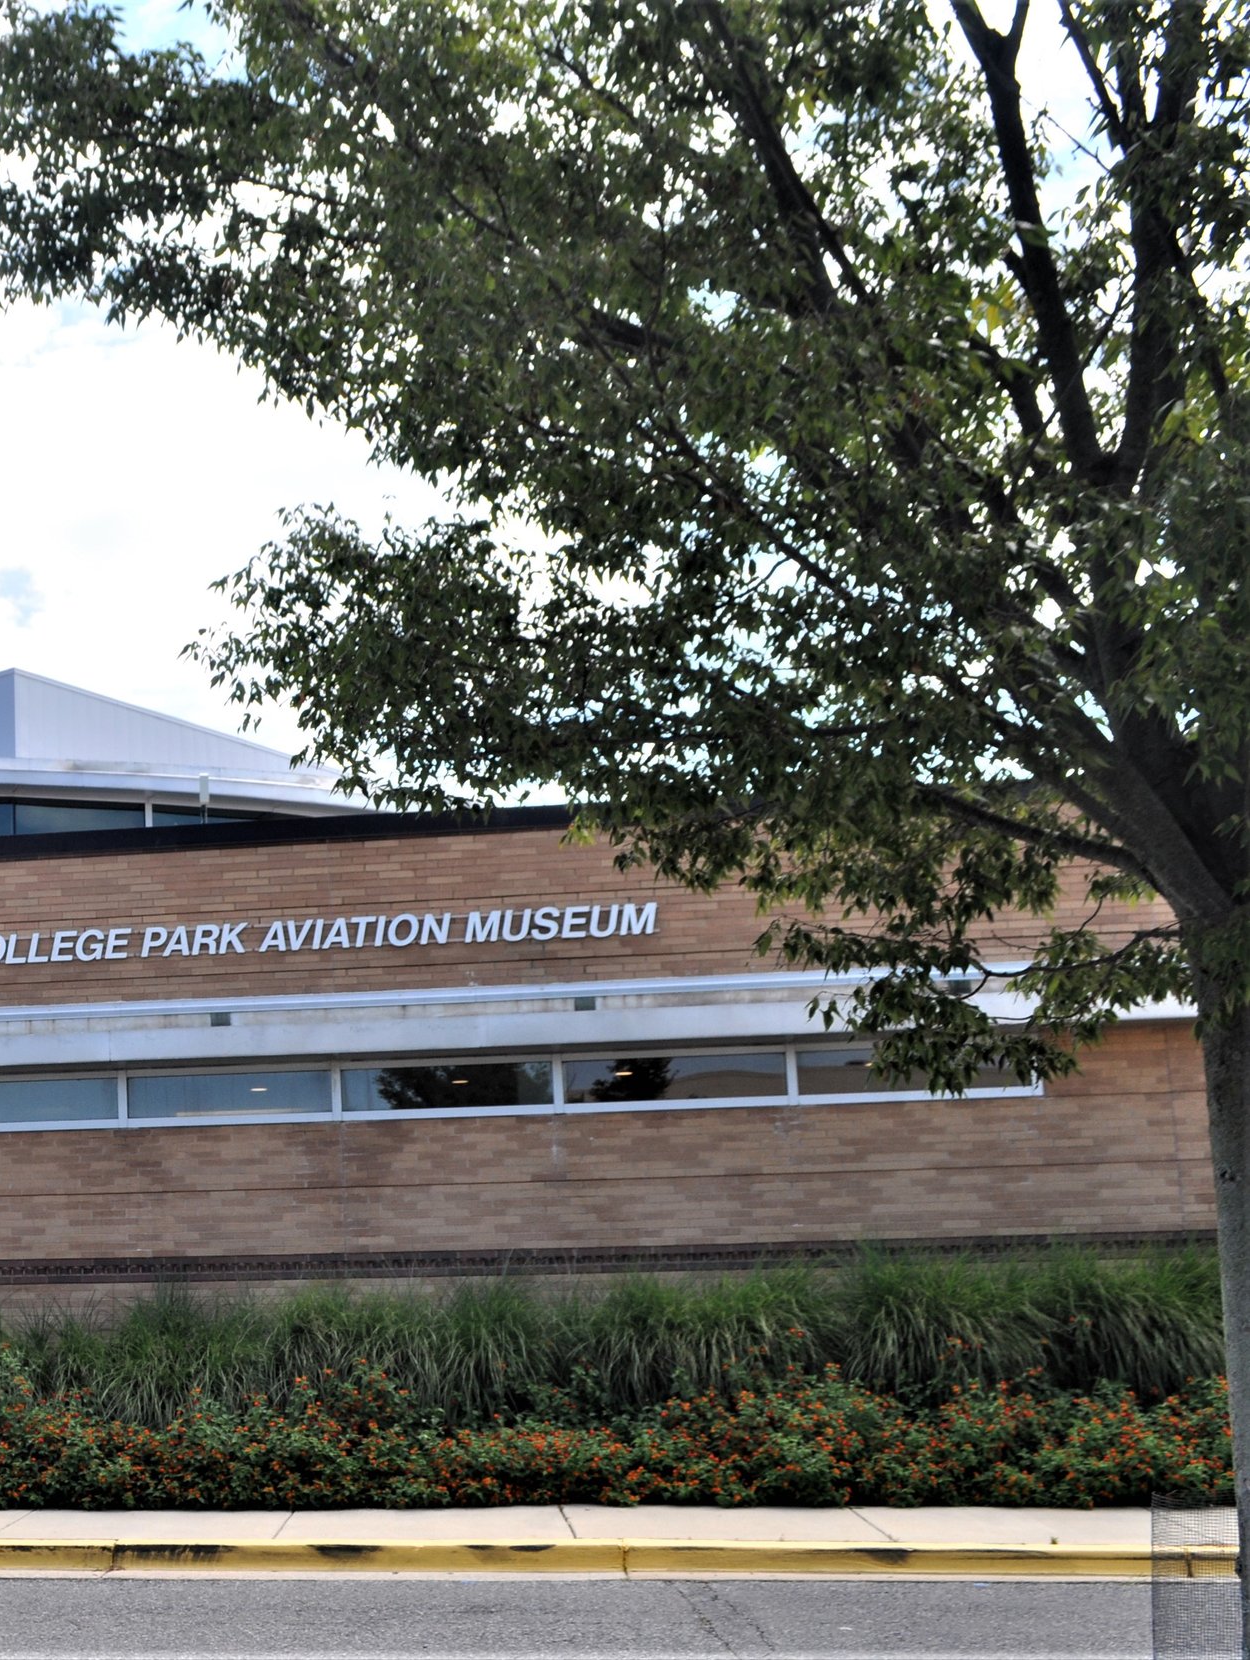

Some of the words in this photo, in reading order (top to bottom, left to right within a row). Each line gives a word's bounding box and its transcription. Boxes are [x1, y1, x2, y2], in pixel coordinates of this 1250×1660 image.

[141, 922, 248, 957] PARK
[258, 912, 451, 952] AVIATION
[464, 902, 657, 943] MUSEUM
